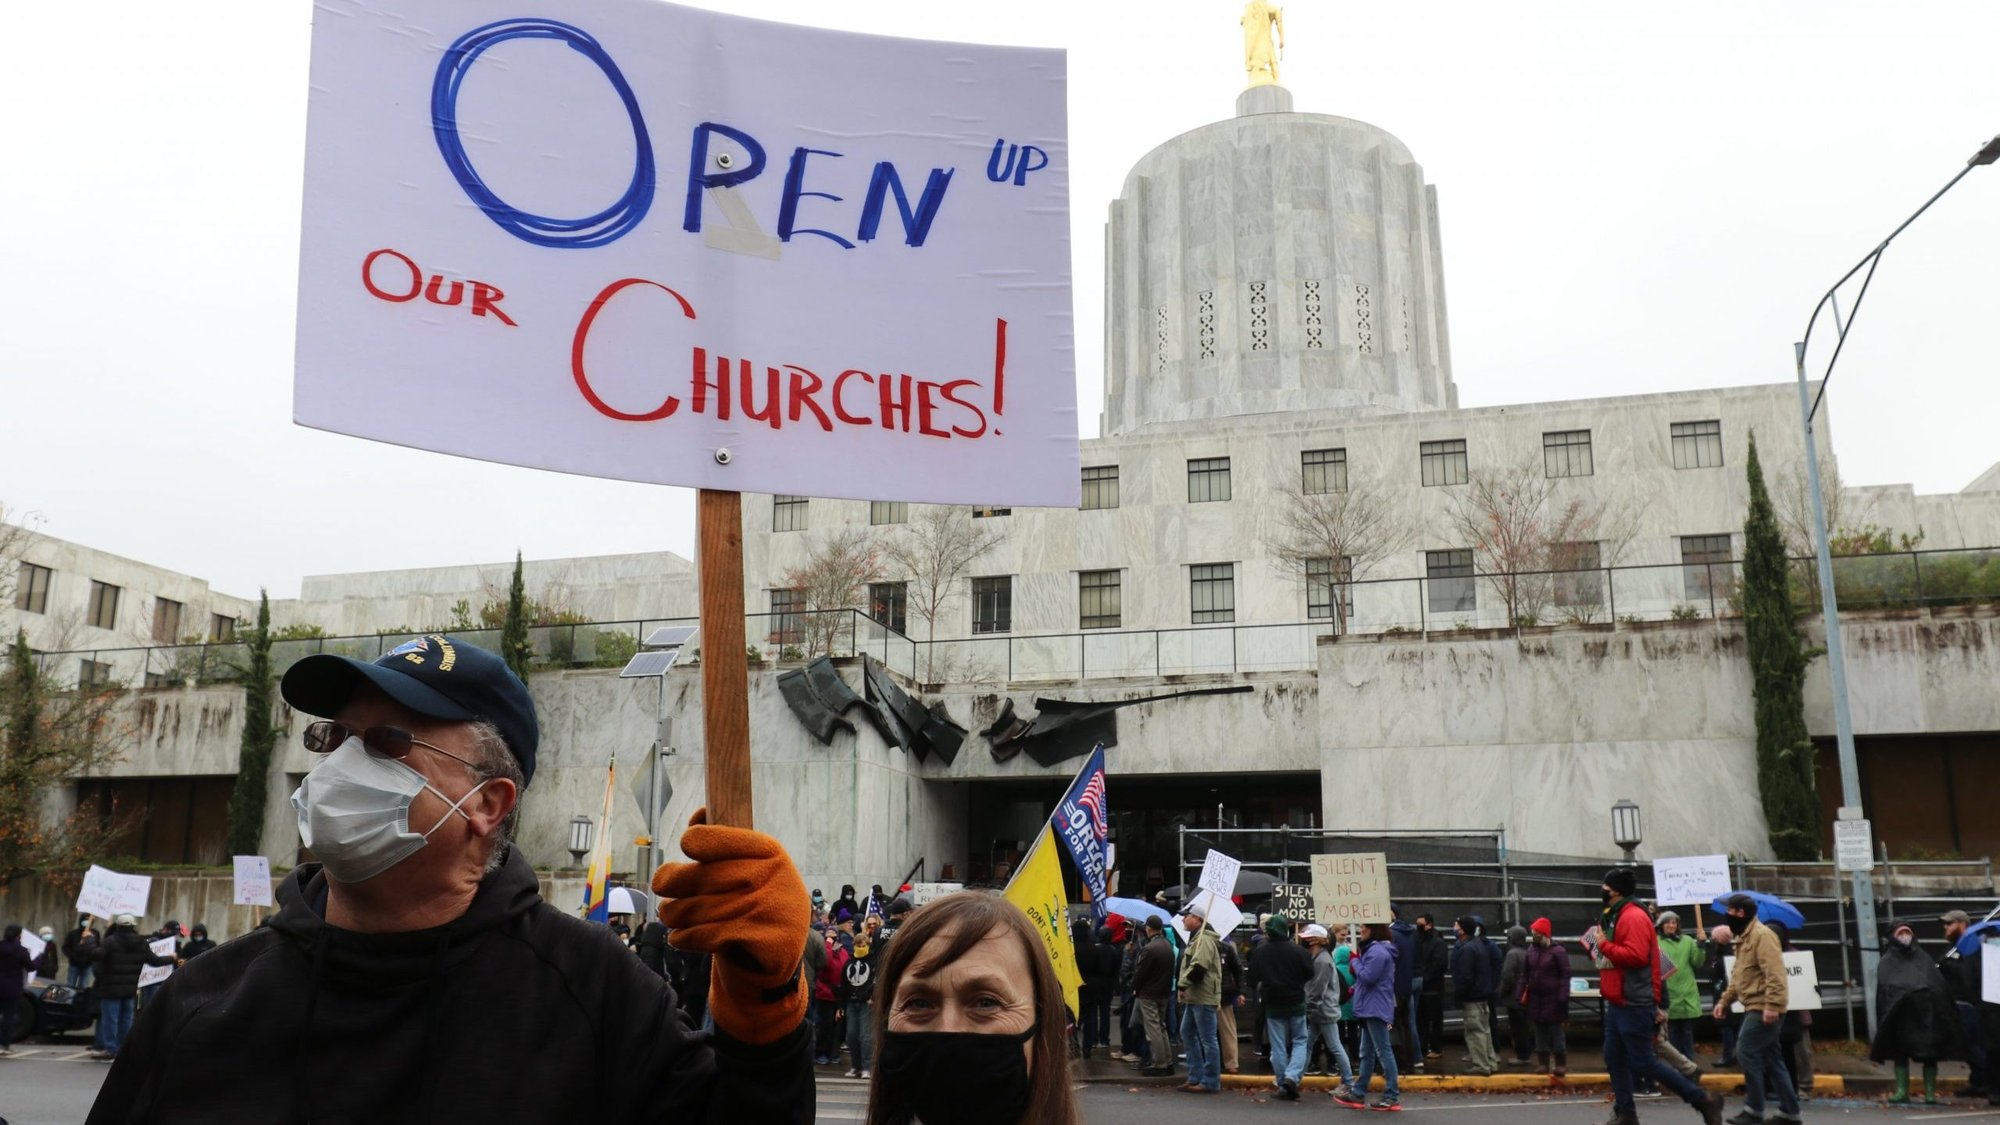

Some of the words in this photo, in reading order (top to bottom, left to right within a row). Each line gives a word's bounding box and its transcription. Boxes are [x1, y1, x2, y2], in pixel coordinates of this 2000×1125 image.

[431, 18, 955, 249] OPEN
[986, 139, 1048, 187] UP
[361, 249, 519, 327] OUR
[571, 278, 1009, 440] CHURCHES!
[1065, 826, 1084, 855] FOR
[1070, 809, 1106, 891] OREG
[1207, 850, 1239, 875] REPORT
[1317, 857, 1377, 876] SILENT
[1274, 885, 1314, 898] SILEN
[1337, 881, 1362, 897] NO
[1288, 897, 1308, 909] NO
[1322, 903, 1381, 920] MORE!!
[1027, 907, 1047, 930] DONT
[1278, 908, 1315, 921] MORE
